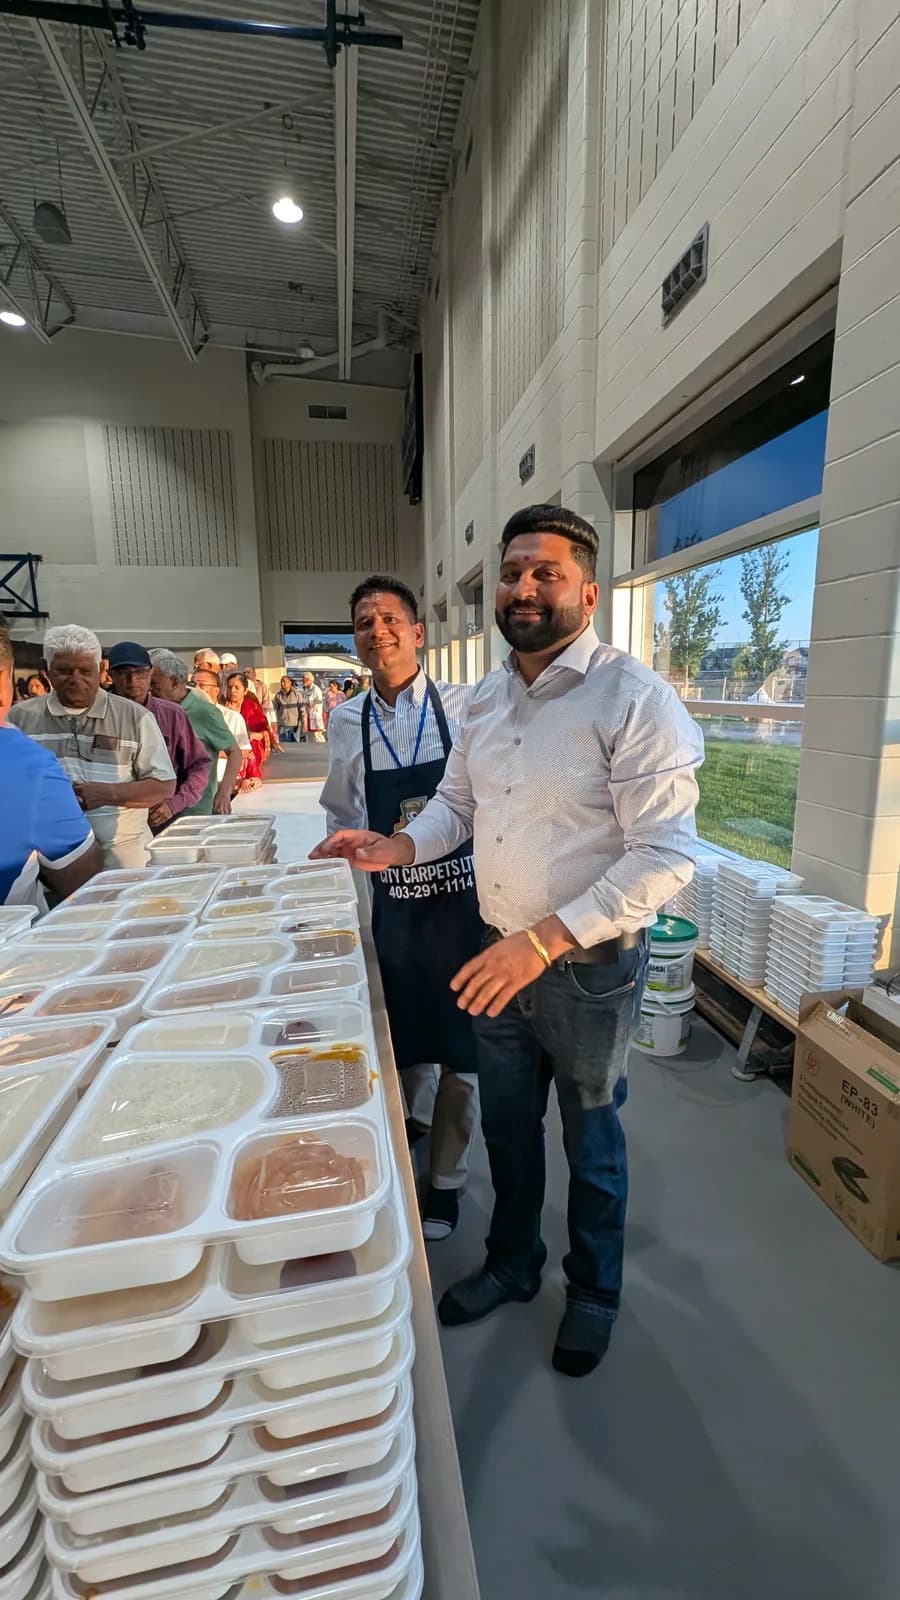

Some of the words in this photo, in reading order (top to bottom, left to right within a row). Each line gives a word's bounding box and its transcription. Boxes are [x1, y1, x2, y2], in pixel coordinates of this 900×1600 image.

[380, 868, 400, 884] CITY
[402, 859, 460, 884] CARPETS
[389, 874, 473, 899] 403-291-1114
[839, 1094, 875, 1129] (WHITE)
